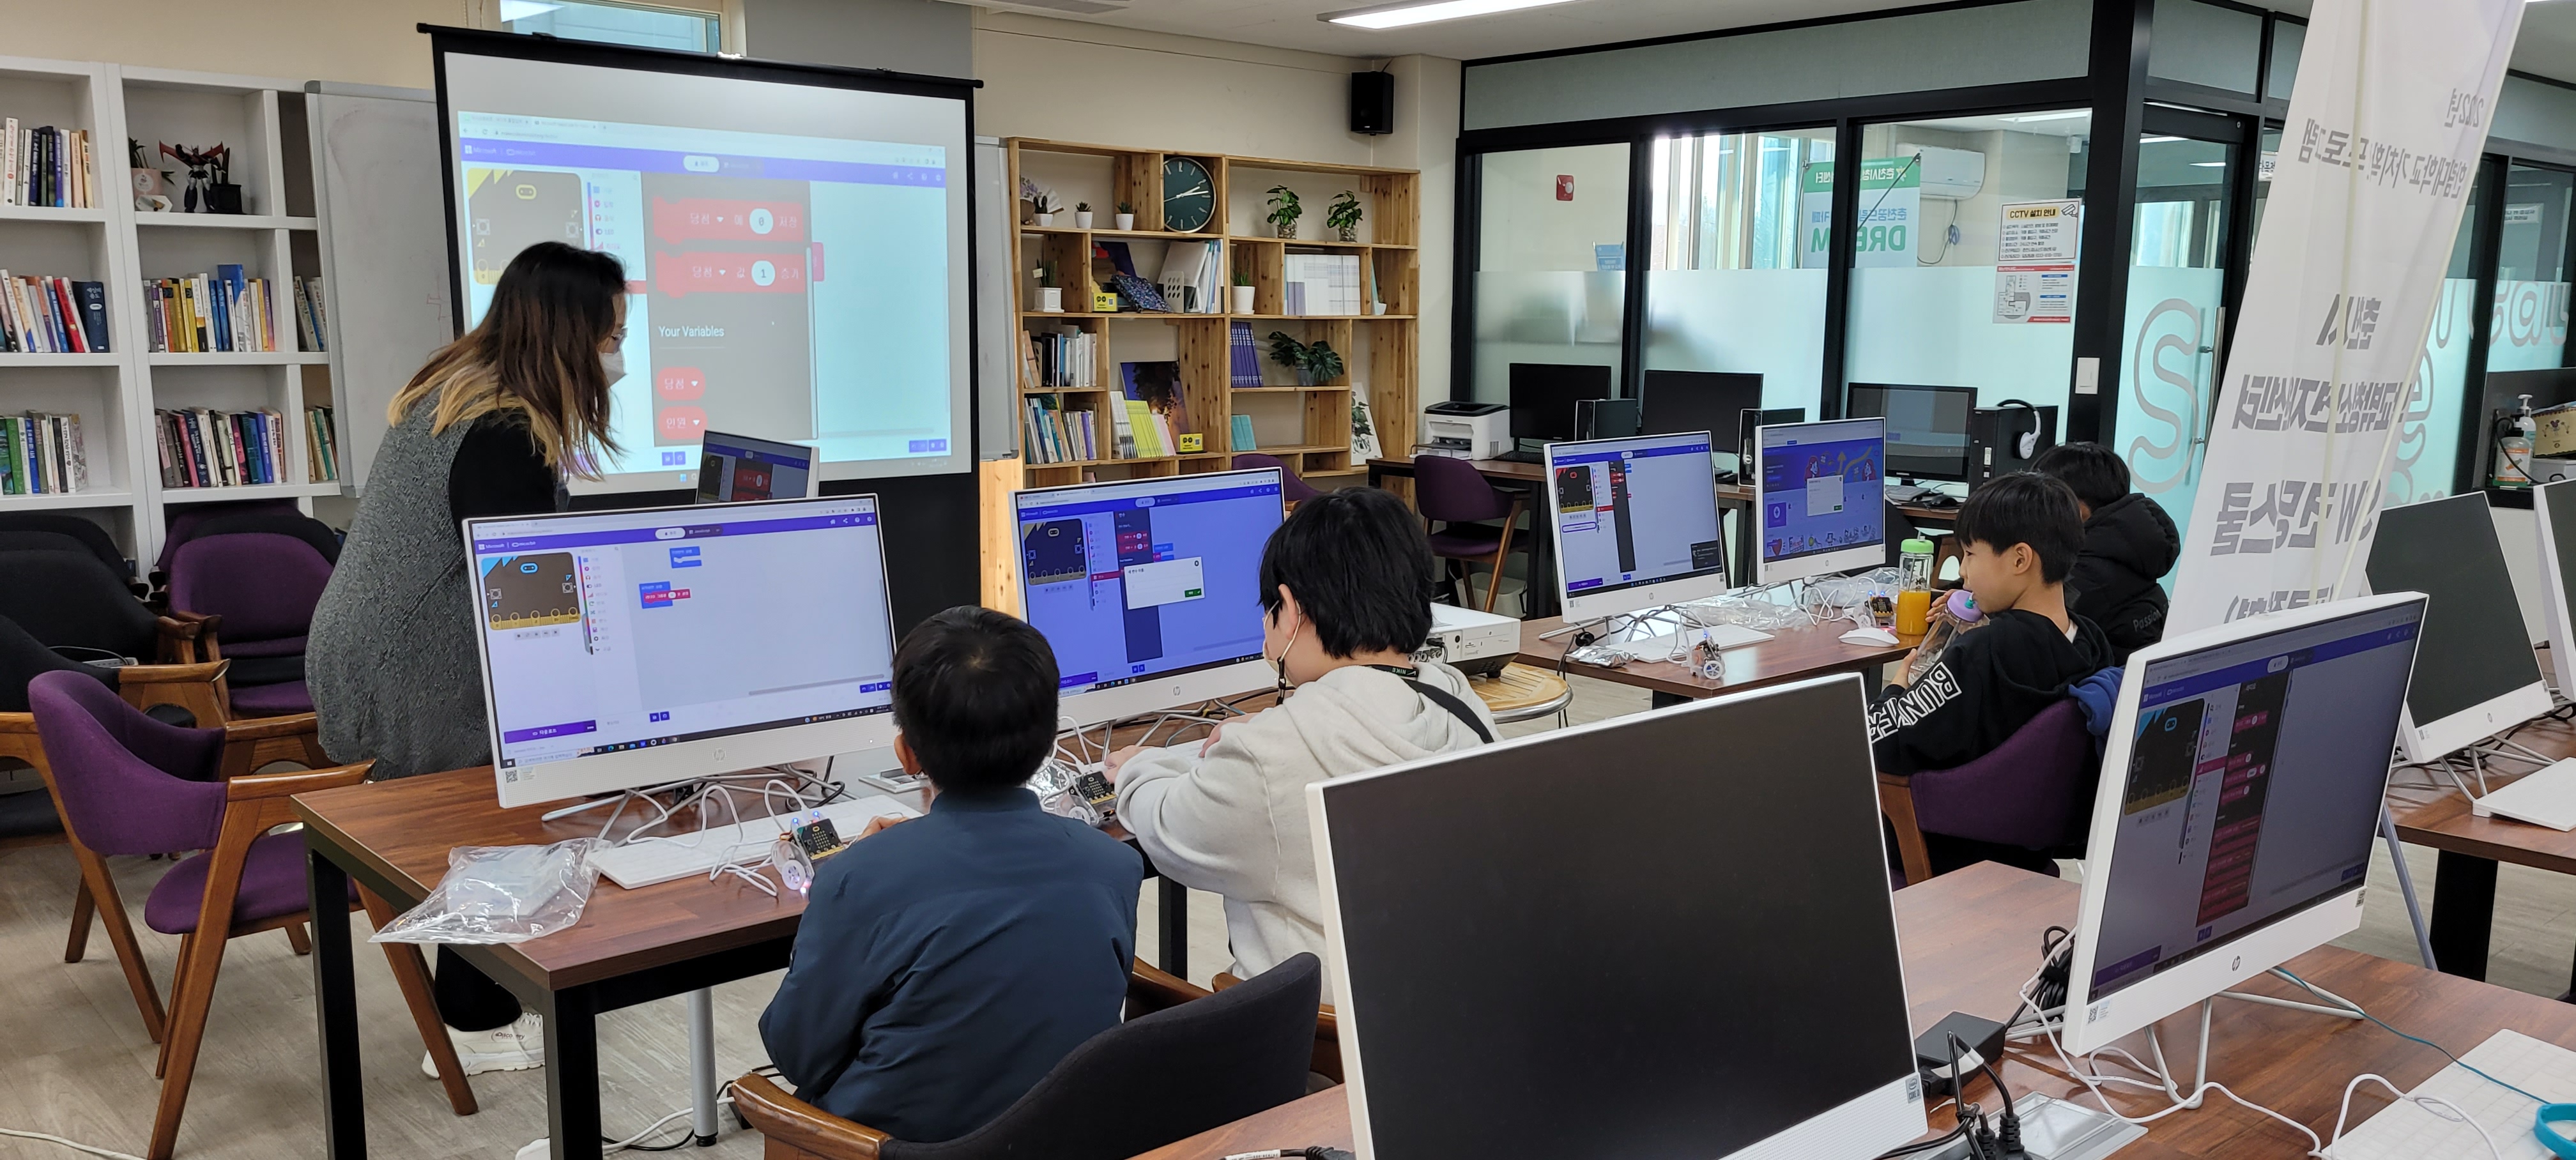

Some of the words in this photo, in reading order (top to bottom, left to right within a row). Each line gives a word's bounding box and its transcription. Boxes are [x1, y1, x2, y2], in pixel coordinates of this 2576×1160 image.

[758, 217, 765, 226] 0
[778, 216, 797, 227] 저장
[761, 269, 766, 279] 1
[659, 326, 680, 337] Your
[682, 325, 724, 337] Variables
